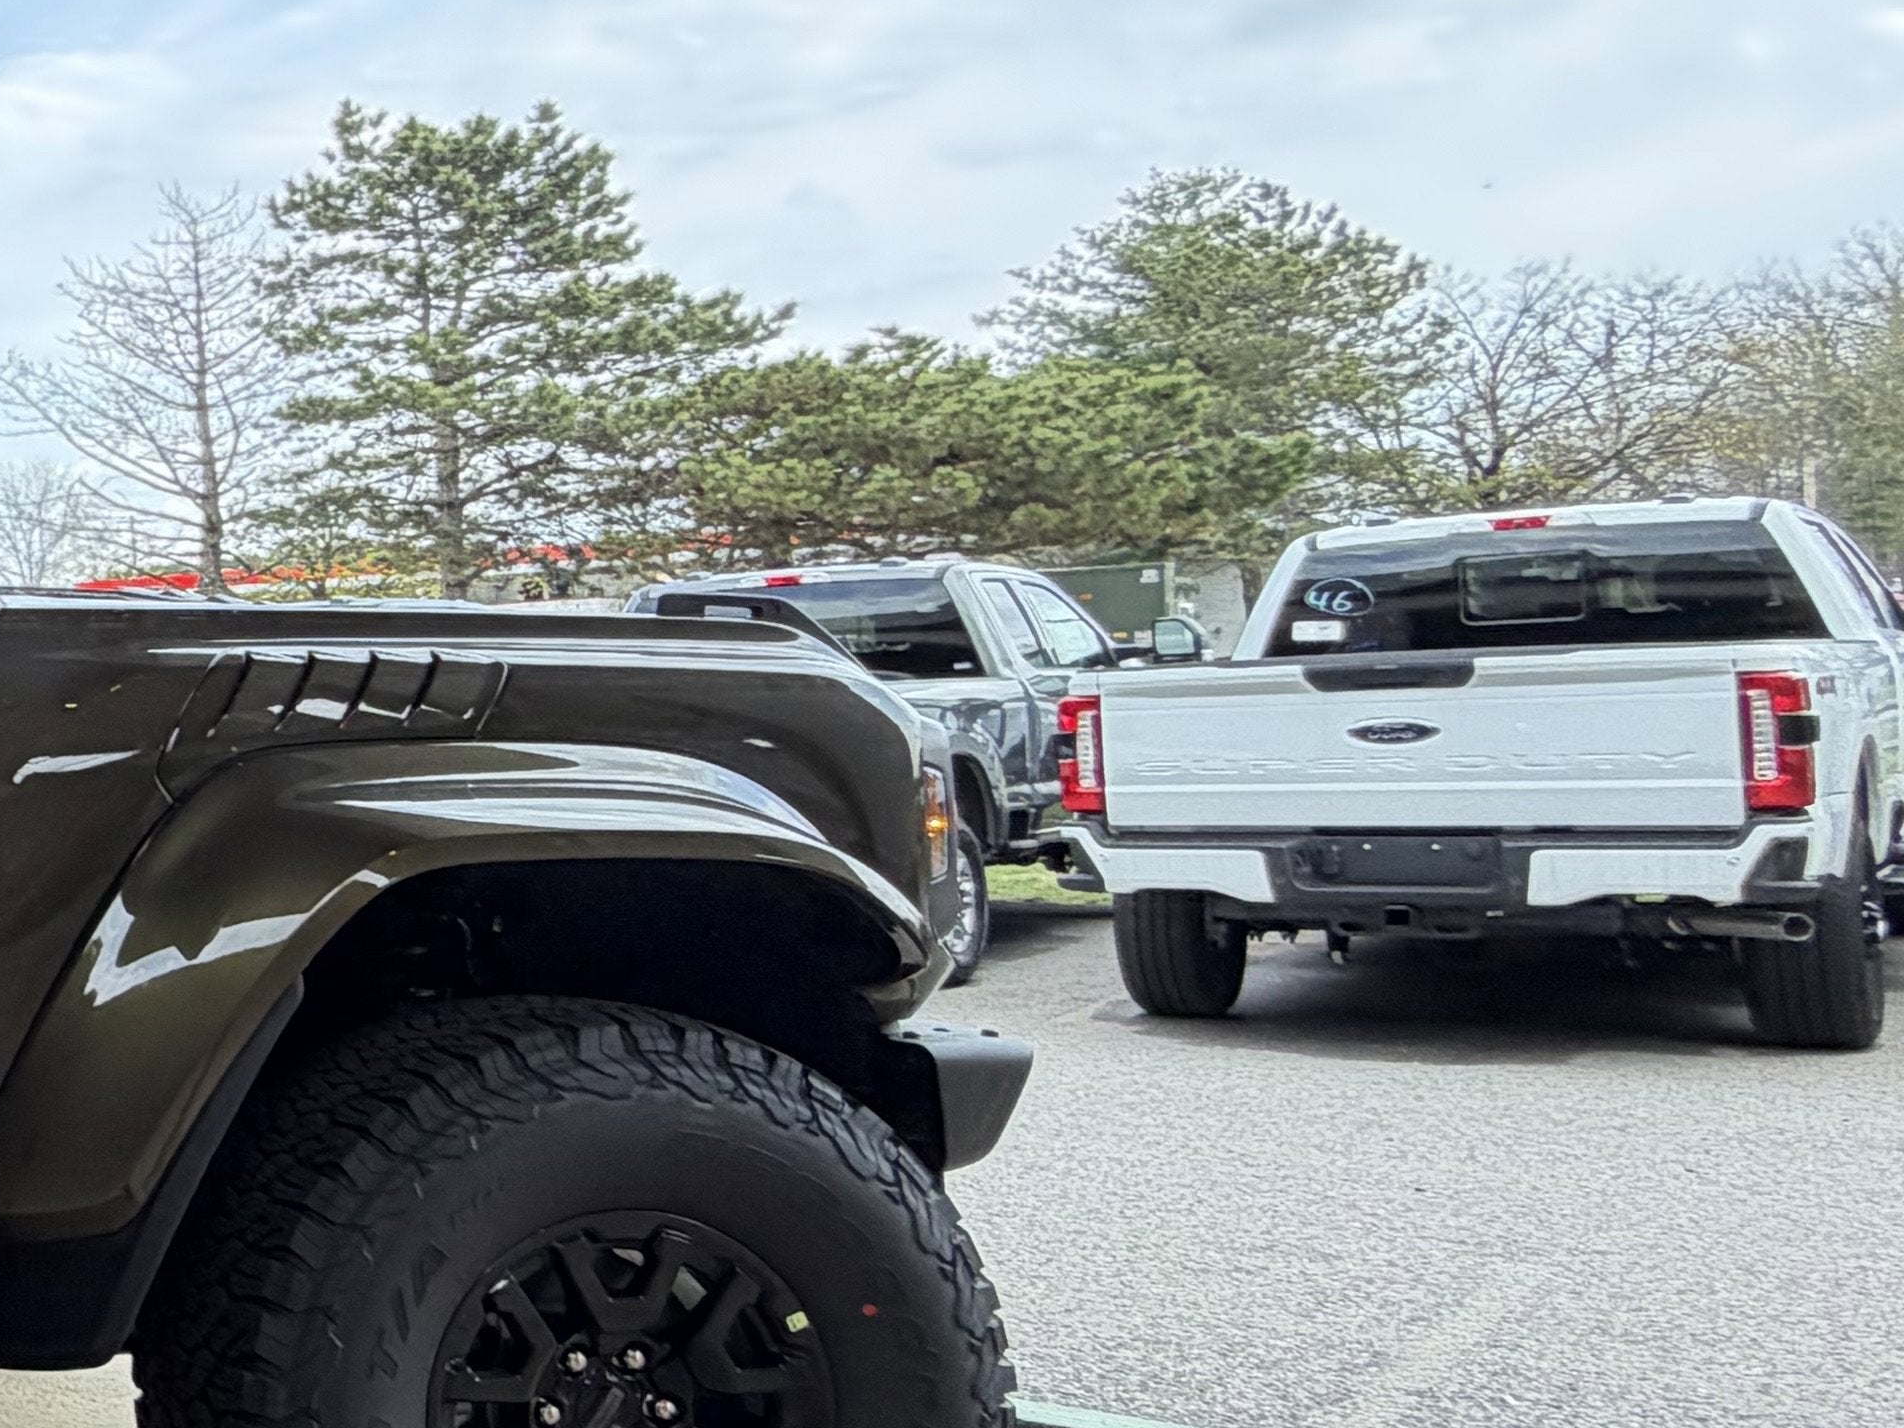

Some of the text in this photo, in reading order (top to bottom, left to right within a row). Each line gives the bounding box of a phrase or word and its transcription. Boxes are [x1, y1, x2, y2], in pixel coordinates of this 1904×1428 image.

[1308, 590, 1353, 612] 46
[1135, 750, 1696, 776] SUPER DUTY
